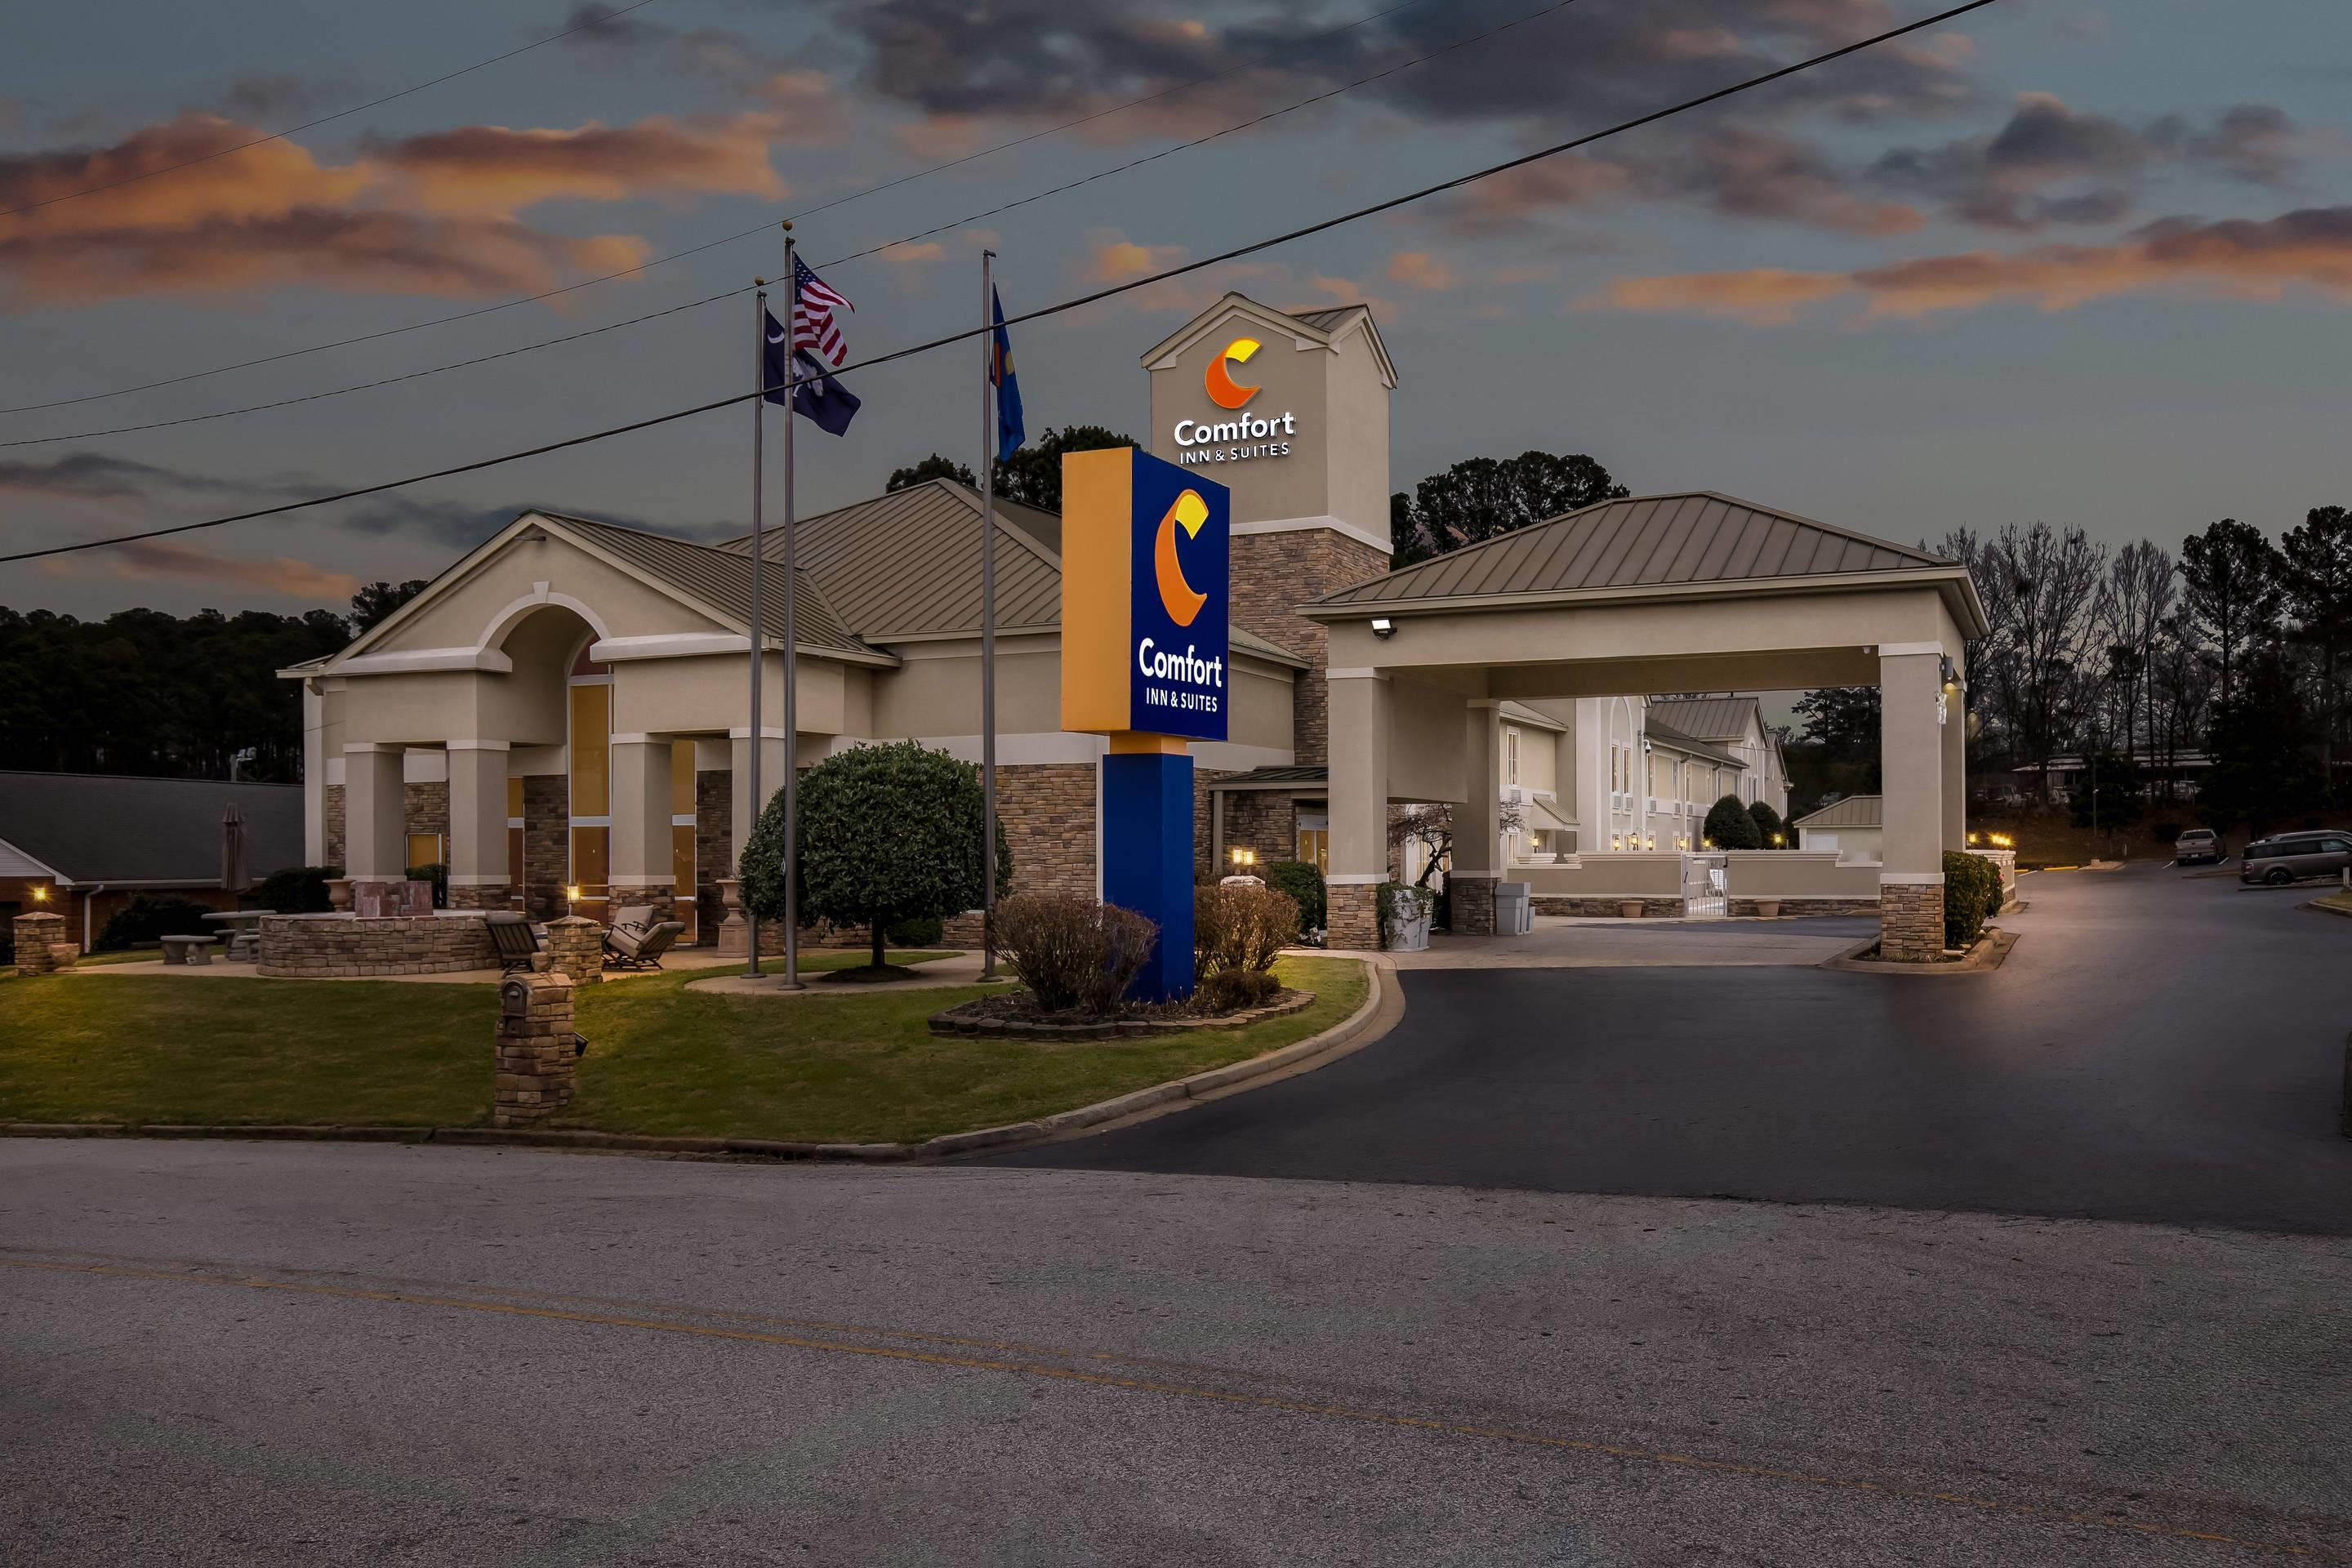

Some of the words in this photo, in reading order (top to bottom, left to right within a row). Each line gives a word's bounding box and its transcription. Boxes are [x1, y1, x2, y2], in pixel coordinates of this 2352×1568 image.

[1174, 412, 1295, 447] Comfort
[1180, 449, 1209, 465] INN
[1215, 449, 1226, 462] &
[1230, 442, 1290, 461] SUITES
[1138, 637, 1223, 688] Comfort
[1146, 687, 1168, 706] INN
[1170, 691, 1178, 707] &
[1180, 693, 1218, 713] SUITES
